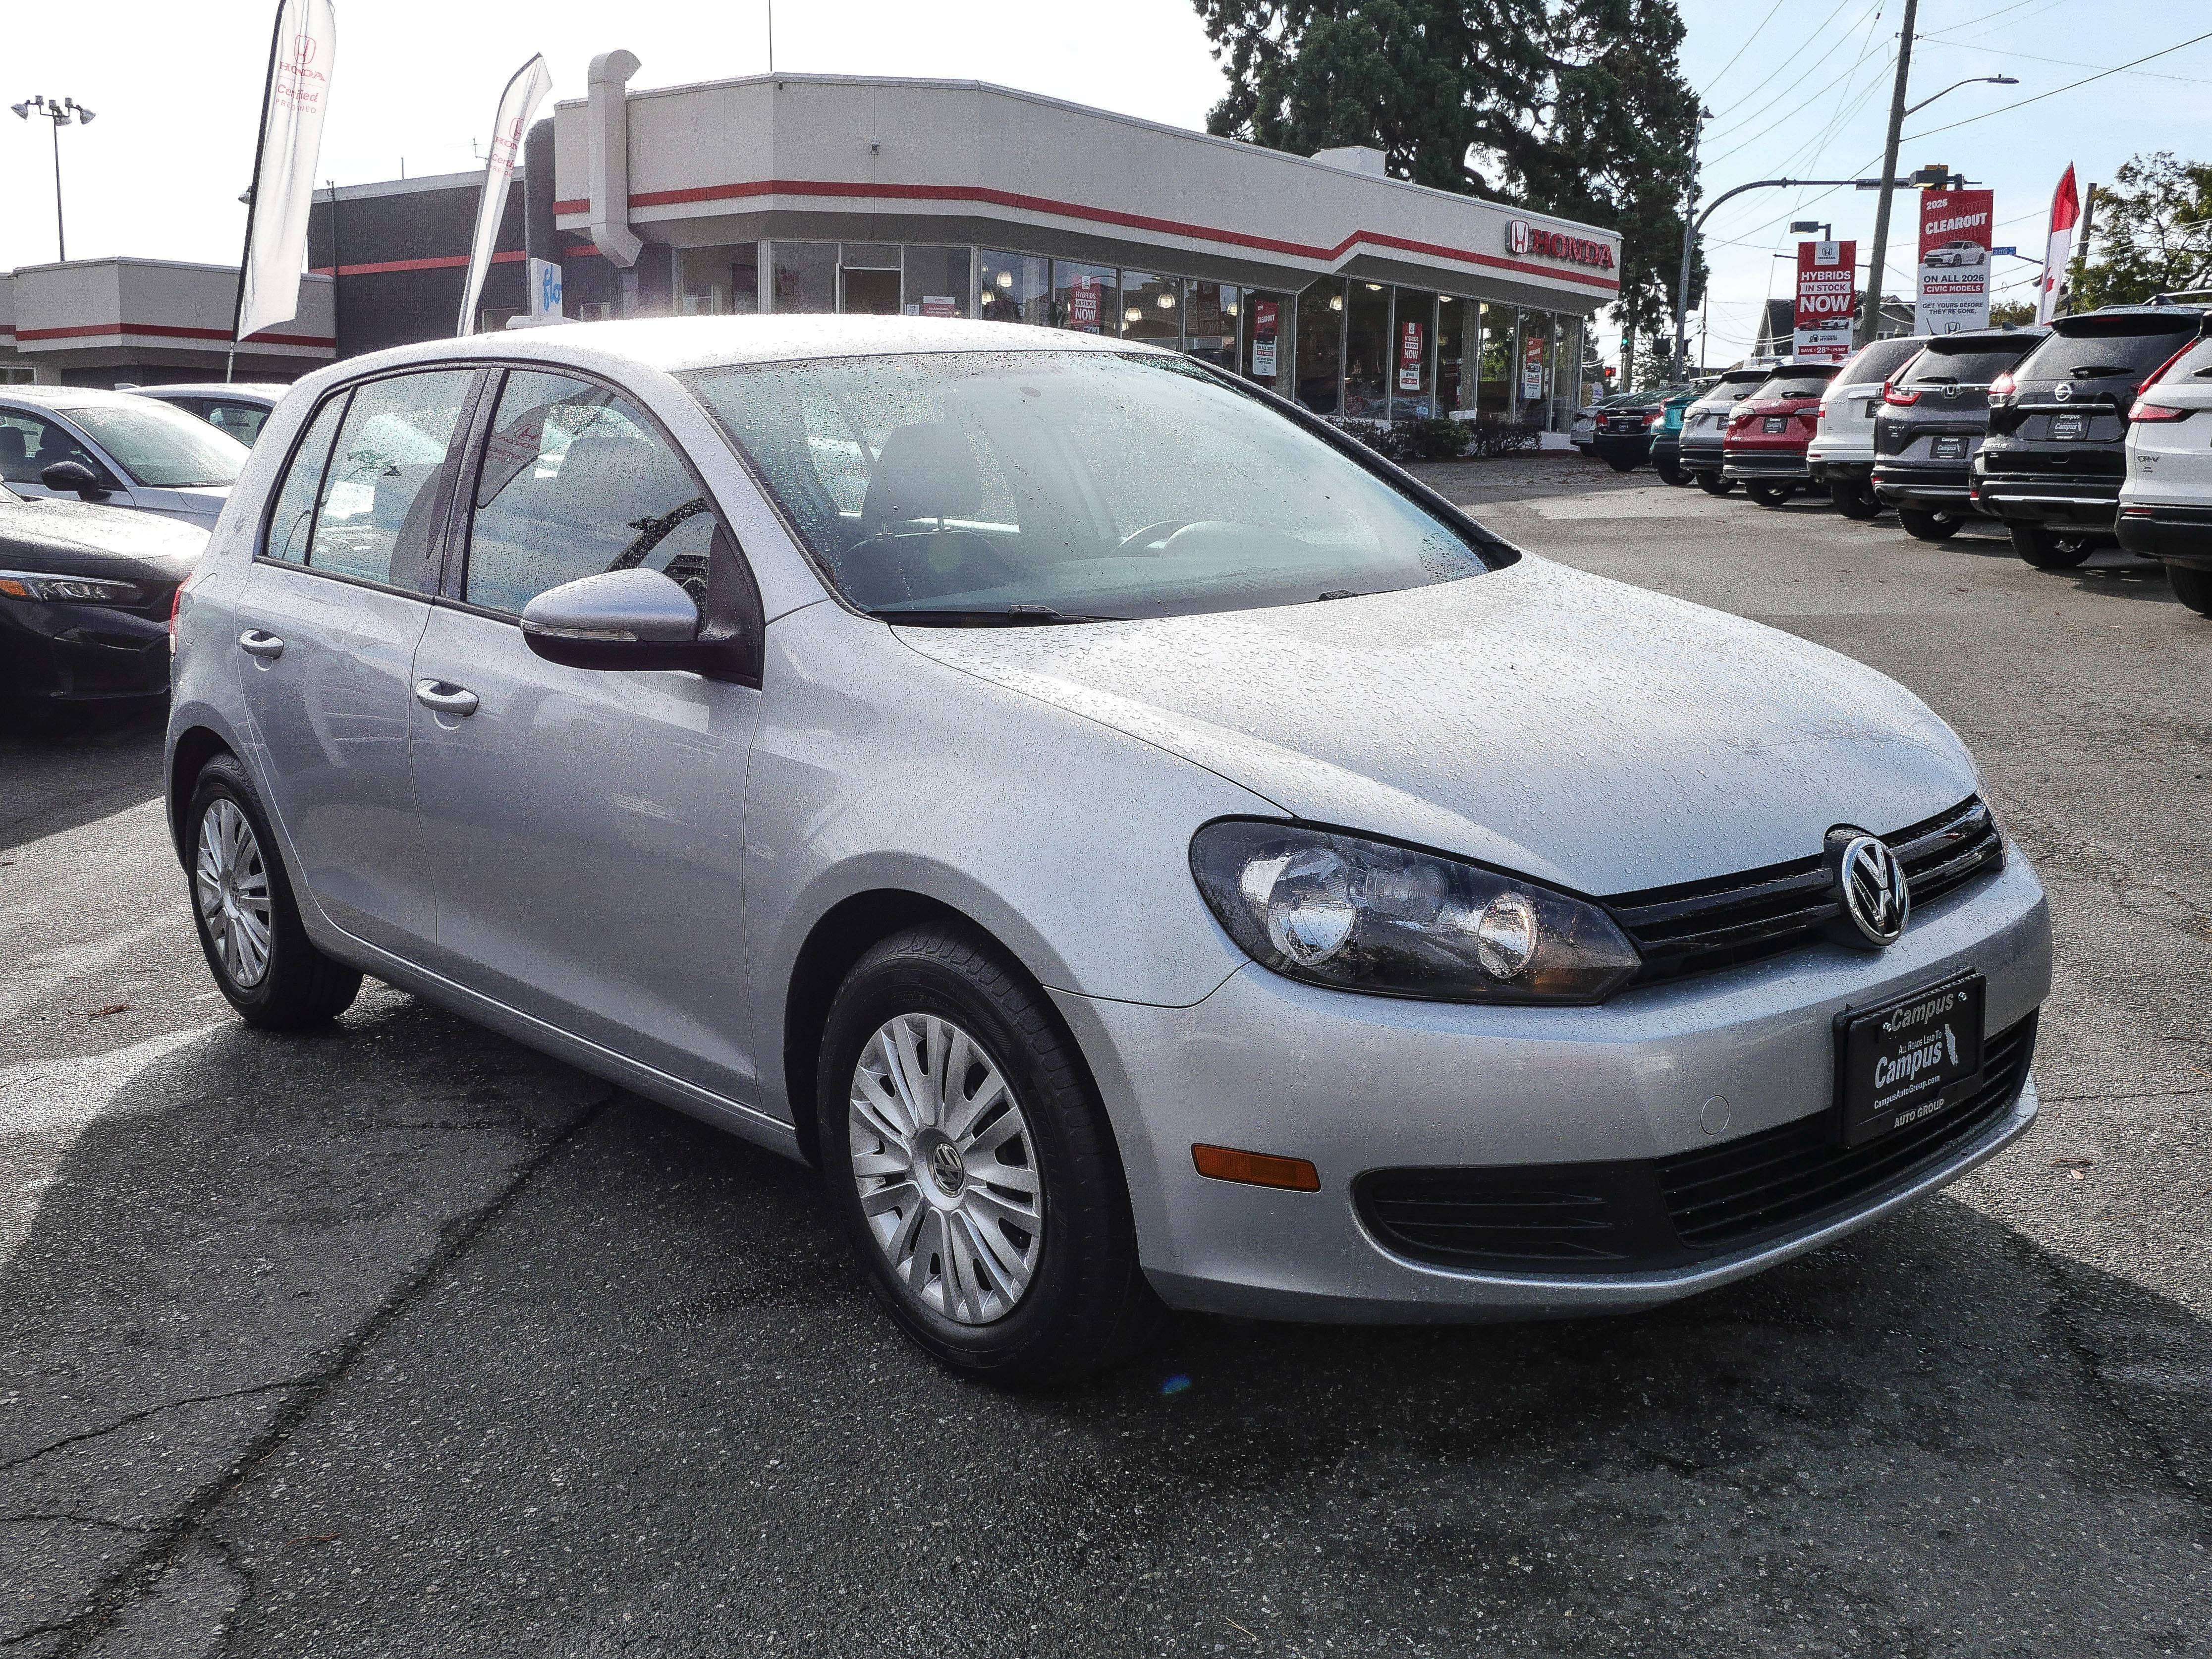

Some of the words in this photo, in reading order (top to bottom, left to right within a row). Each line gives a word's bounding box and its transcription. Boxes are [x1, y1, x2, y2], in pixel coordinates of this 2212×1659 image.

[279, 61, 326, 82] HONDA
[1926, 199, 1948, 210] 2026
[1925, 212, 1988, 235] CLEAROUT
[1531, 228, 1615, 269] HONDA
[1801, 271, 1851, 281] HYBRIDS
[1940, 275, 1959, 283] ALL
[1075, 291, 1097, 300] HYBRIDS
[1800, 295, 1850, 312] NOW
[1075, 308, 1096, 321] NOW
[1257, 314, 1274, 323] CLEAROUT
[1404, 349, 1418, 359] NOW
[2054, 423, 2078, 432] Campus
[1891, 994, 1954, 1032] Campus
[1875, 1042, 1942, 1089] Campus
[1874, 1075, 1940, 1109] CampusAutoGroup.com
[1894, 1110, 1916, 1128] AUTO
[1917, 1098, 1944, 1117] GROUP
